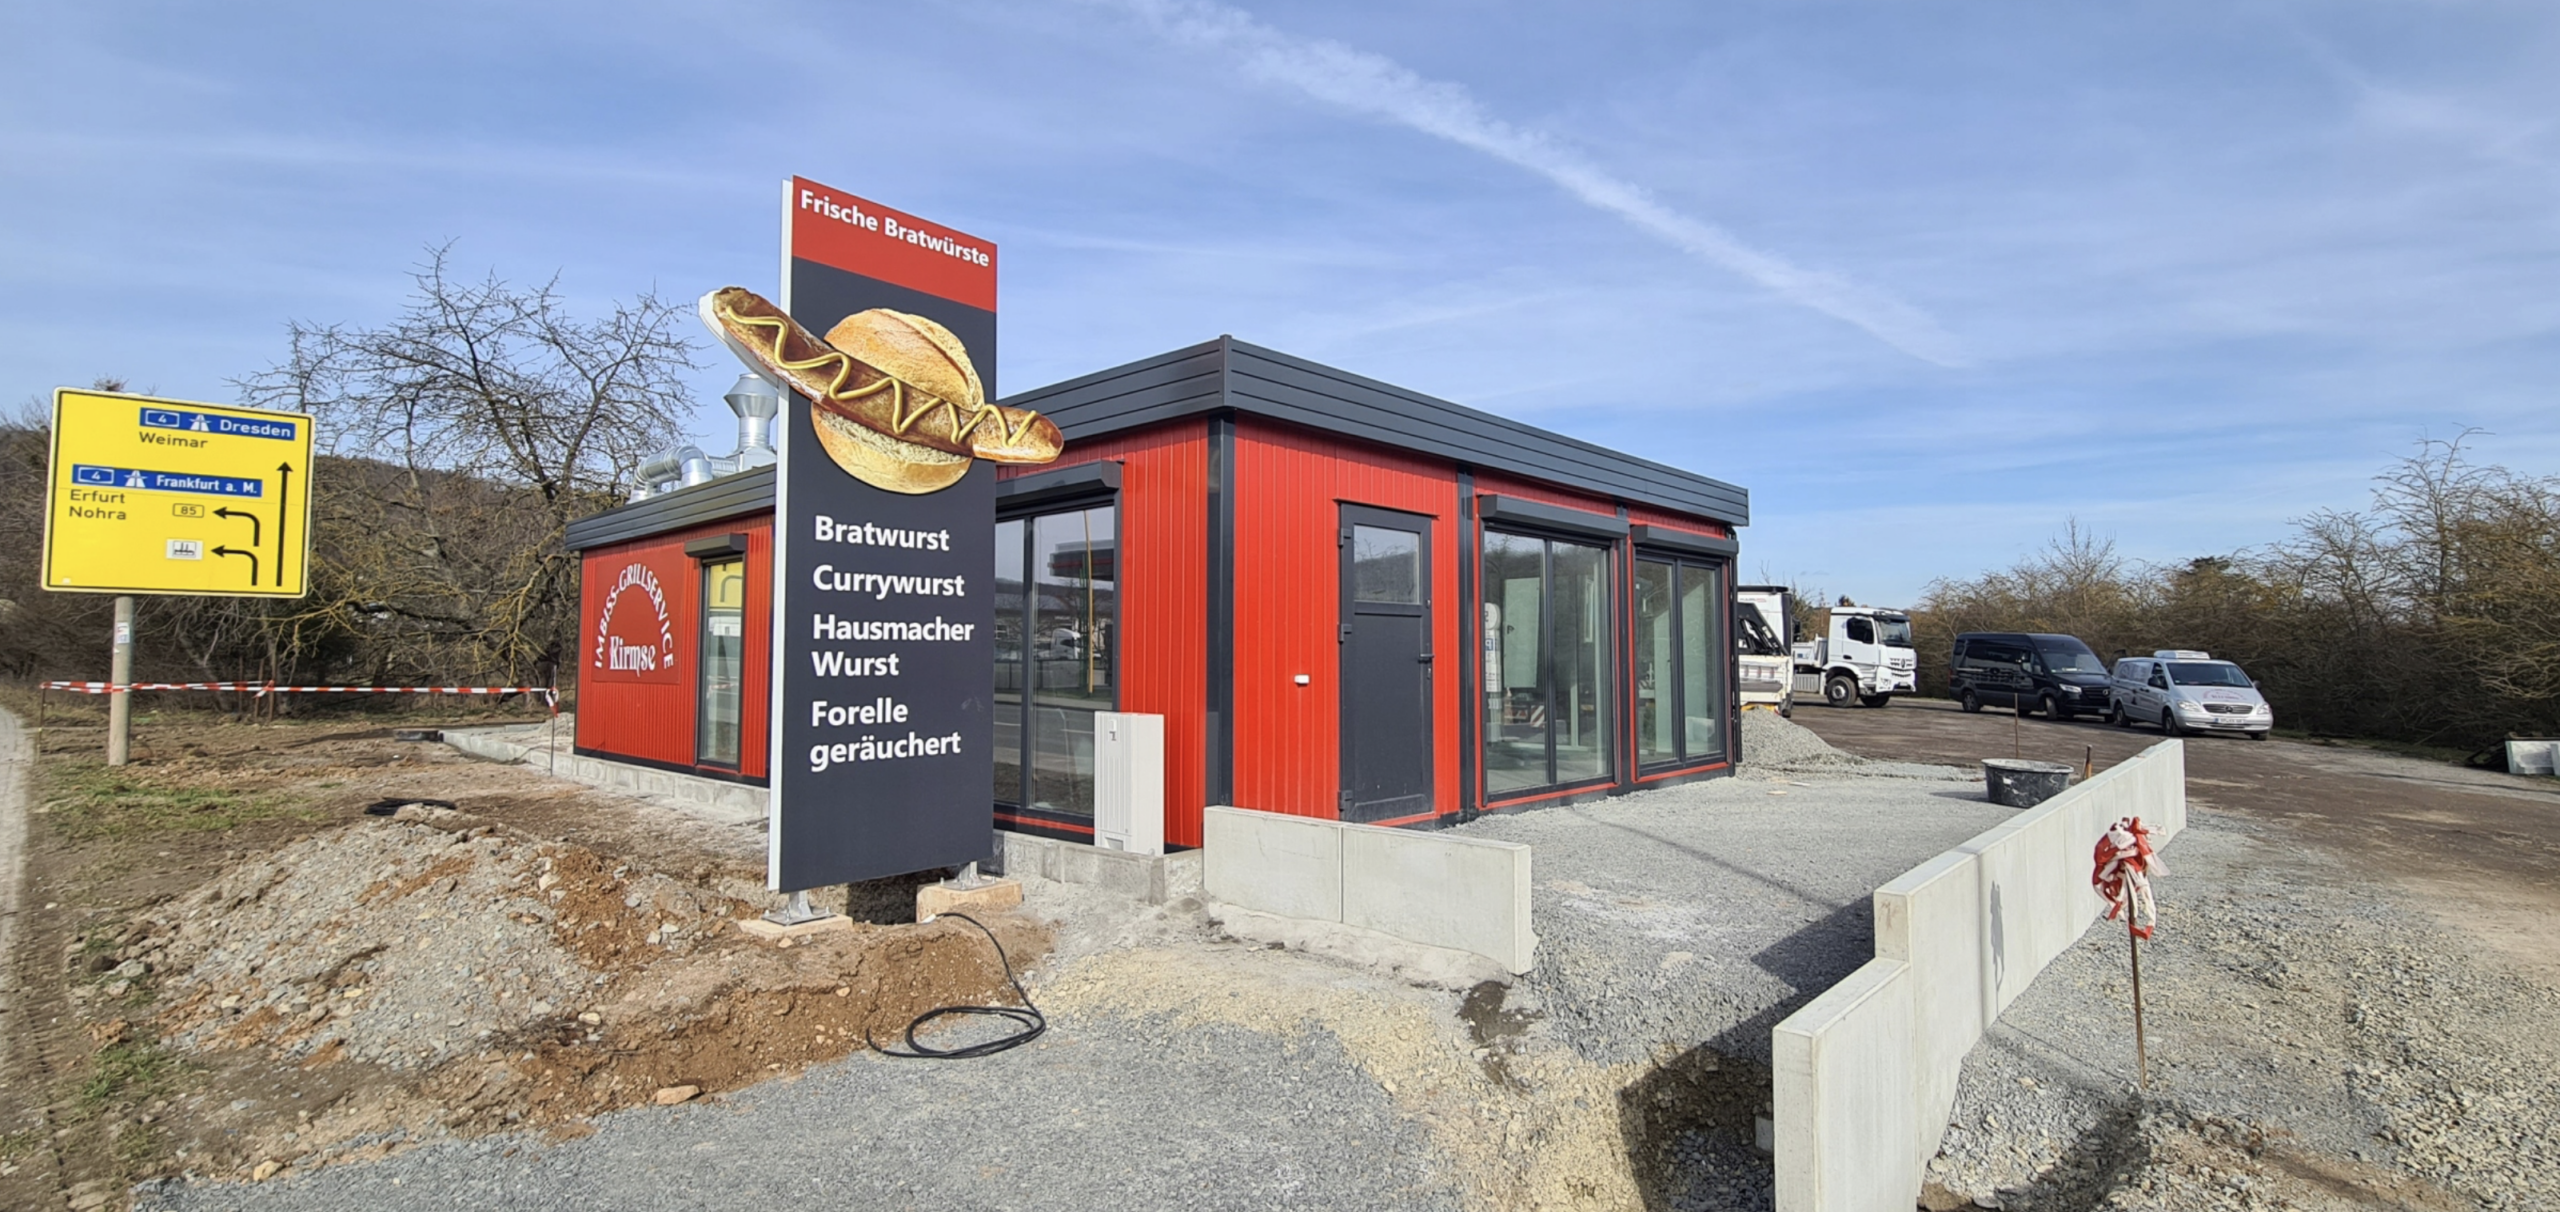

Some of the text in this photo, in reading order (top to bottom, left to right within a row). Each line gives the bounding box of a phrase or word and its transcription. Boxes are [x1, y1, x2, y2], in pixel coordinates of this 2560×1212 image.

[801, 189, 990, 267] Frische Bratwürste
[158, 414, 291, 438] 4 Dresden
[139, 431, 208, 449] Weimar
[91, 471, 257, 494] 4 Frankfurt a. M.
[70, 489, 125, 504] Erfurt
[69, 506, 127, 521] Nohra
[180, 506, 197, 516] 85
[814, 515, 950, 552] Bratwurst
[812, 564, 965, 600] Currywurst
[812, 613, 975, 642] Hausmacher
[609, 635, 657, 677] Kirmse
[811, 651, 900, 677] Wurst
[811, 697, 909, 728] Forelle
[809, 731, 962, 773] geräuchert
